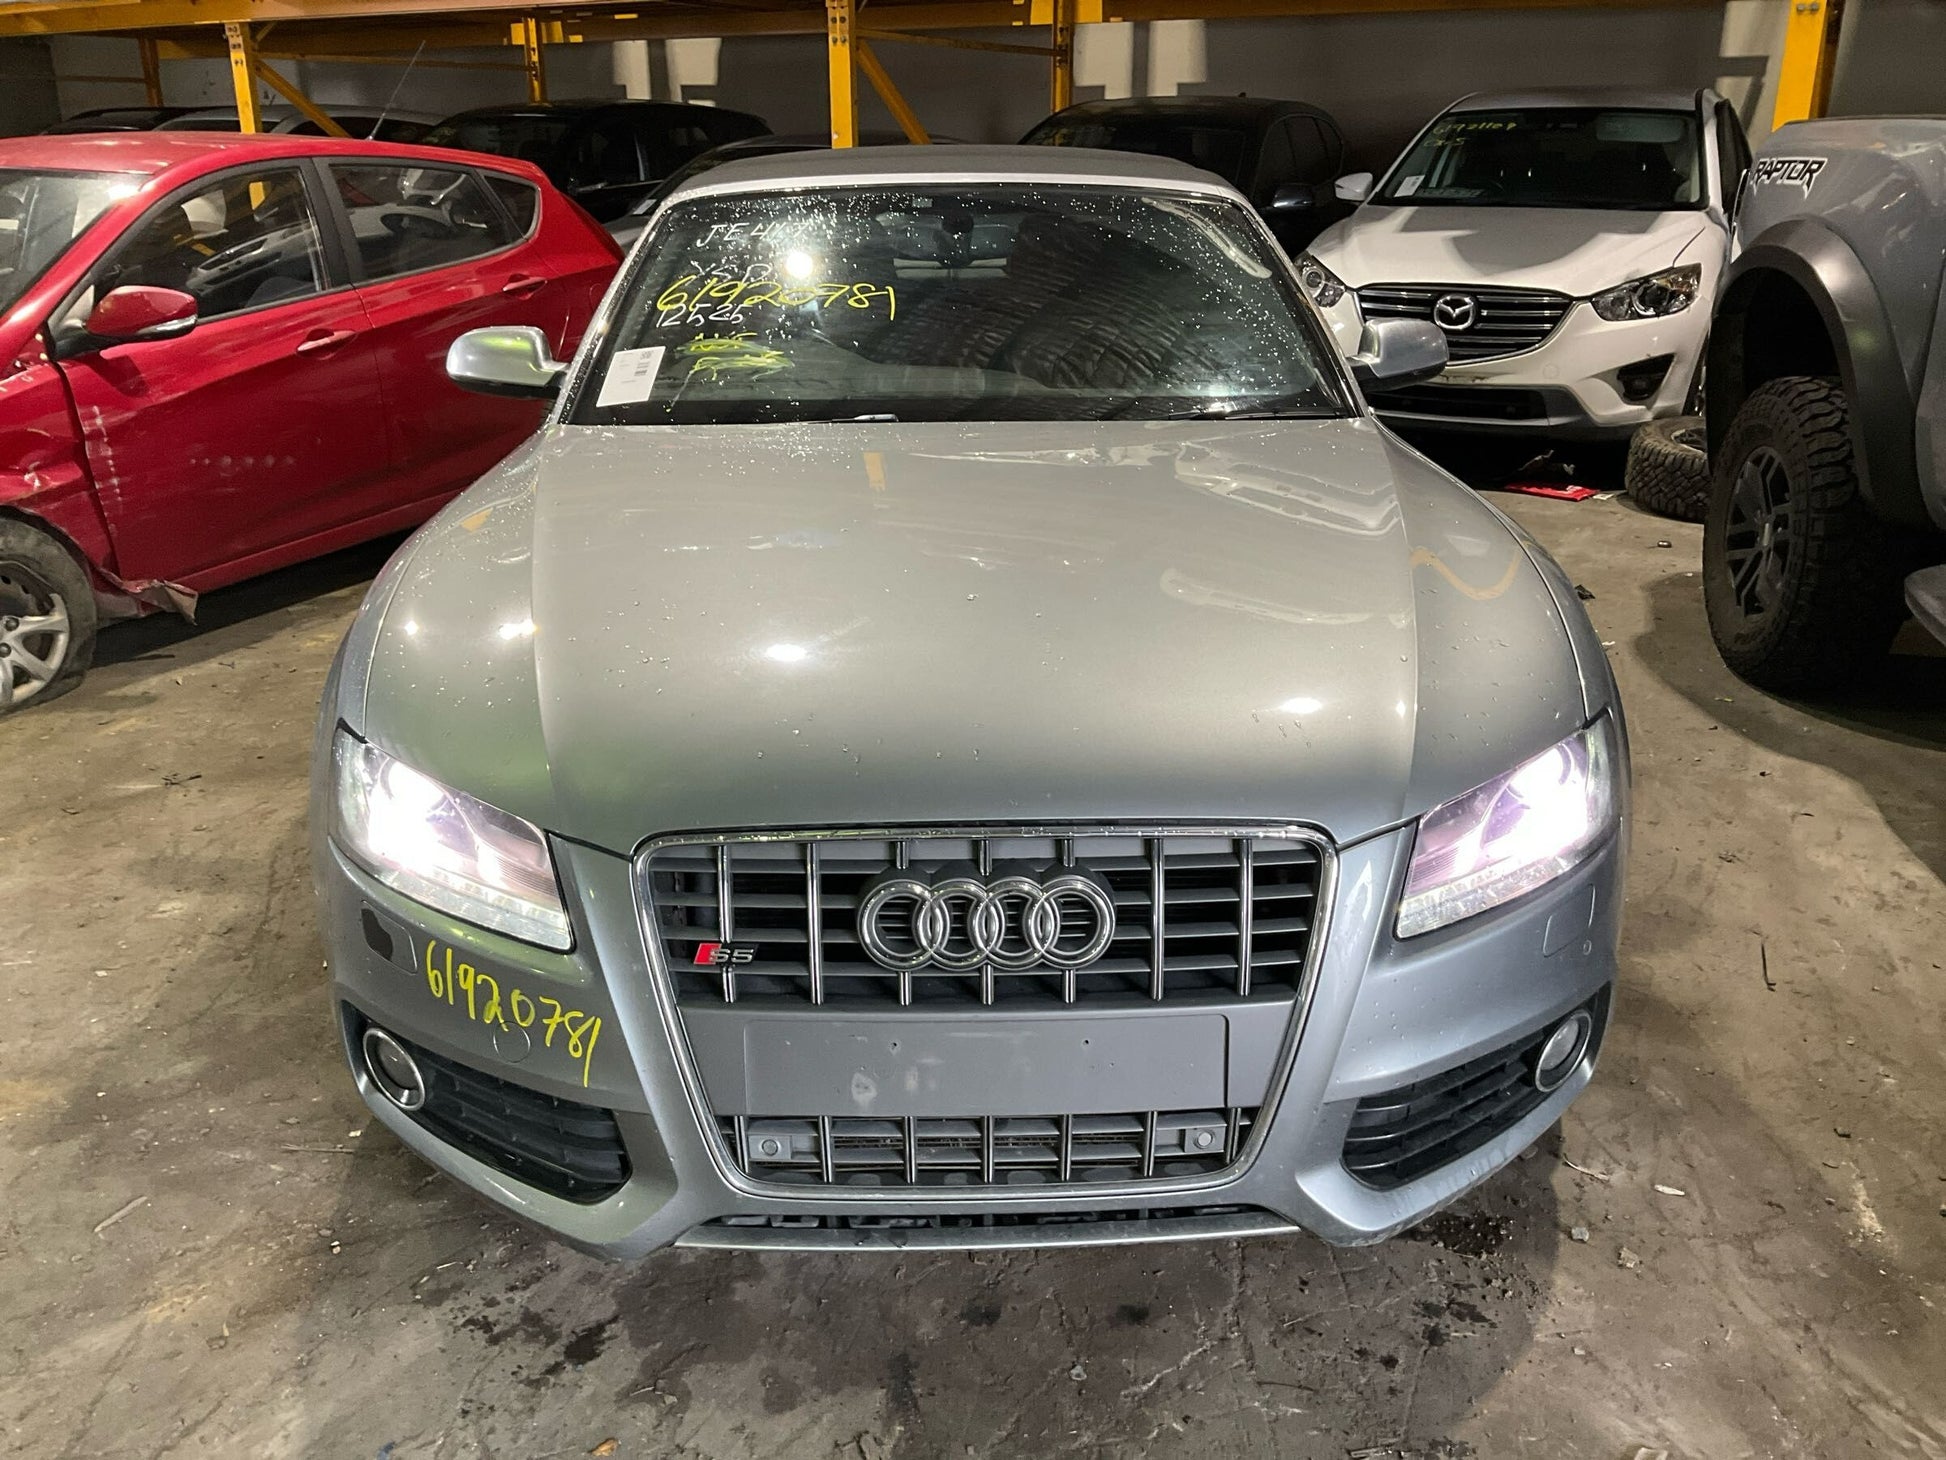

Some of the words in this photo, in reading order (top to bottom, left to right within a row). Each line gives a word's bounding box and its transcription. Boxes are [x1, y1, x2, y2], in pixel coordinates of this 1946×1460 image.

[1753, 156, 1828, 199] RAPTOR
[655, 303, 753, 328] 12525
[656, 275, 896, 321] 61920781
[709, 948, 754, 963] S5
[426, 940, 602, 1088] 61920781
